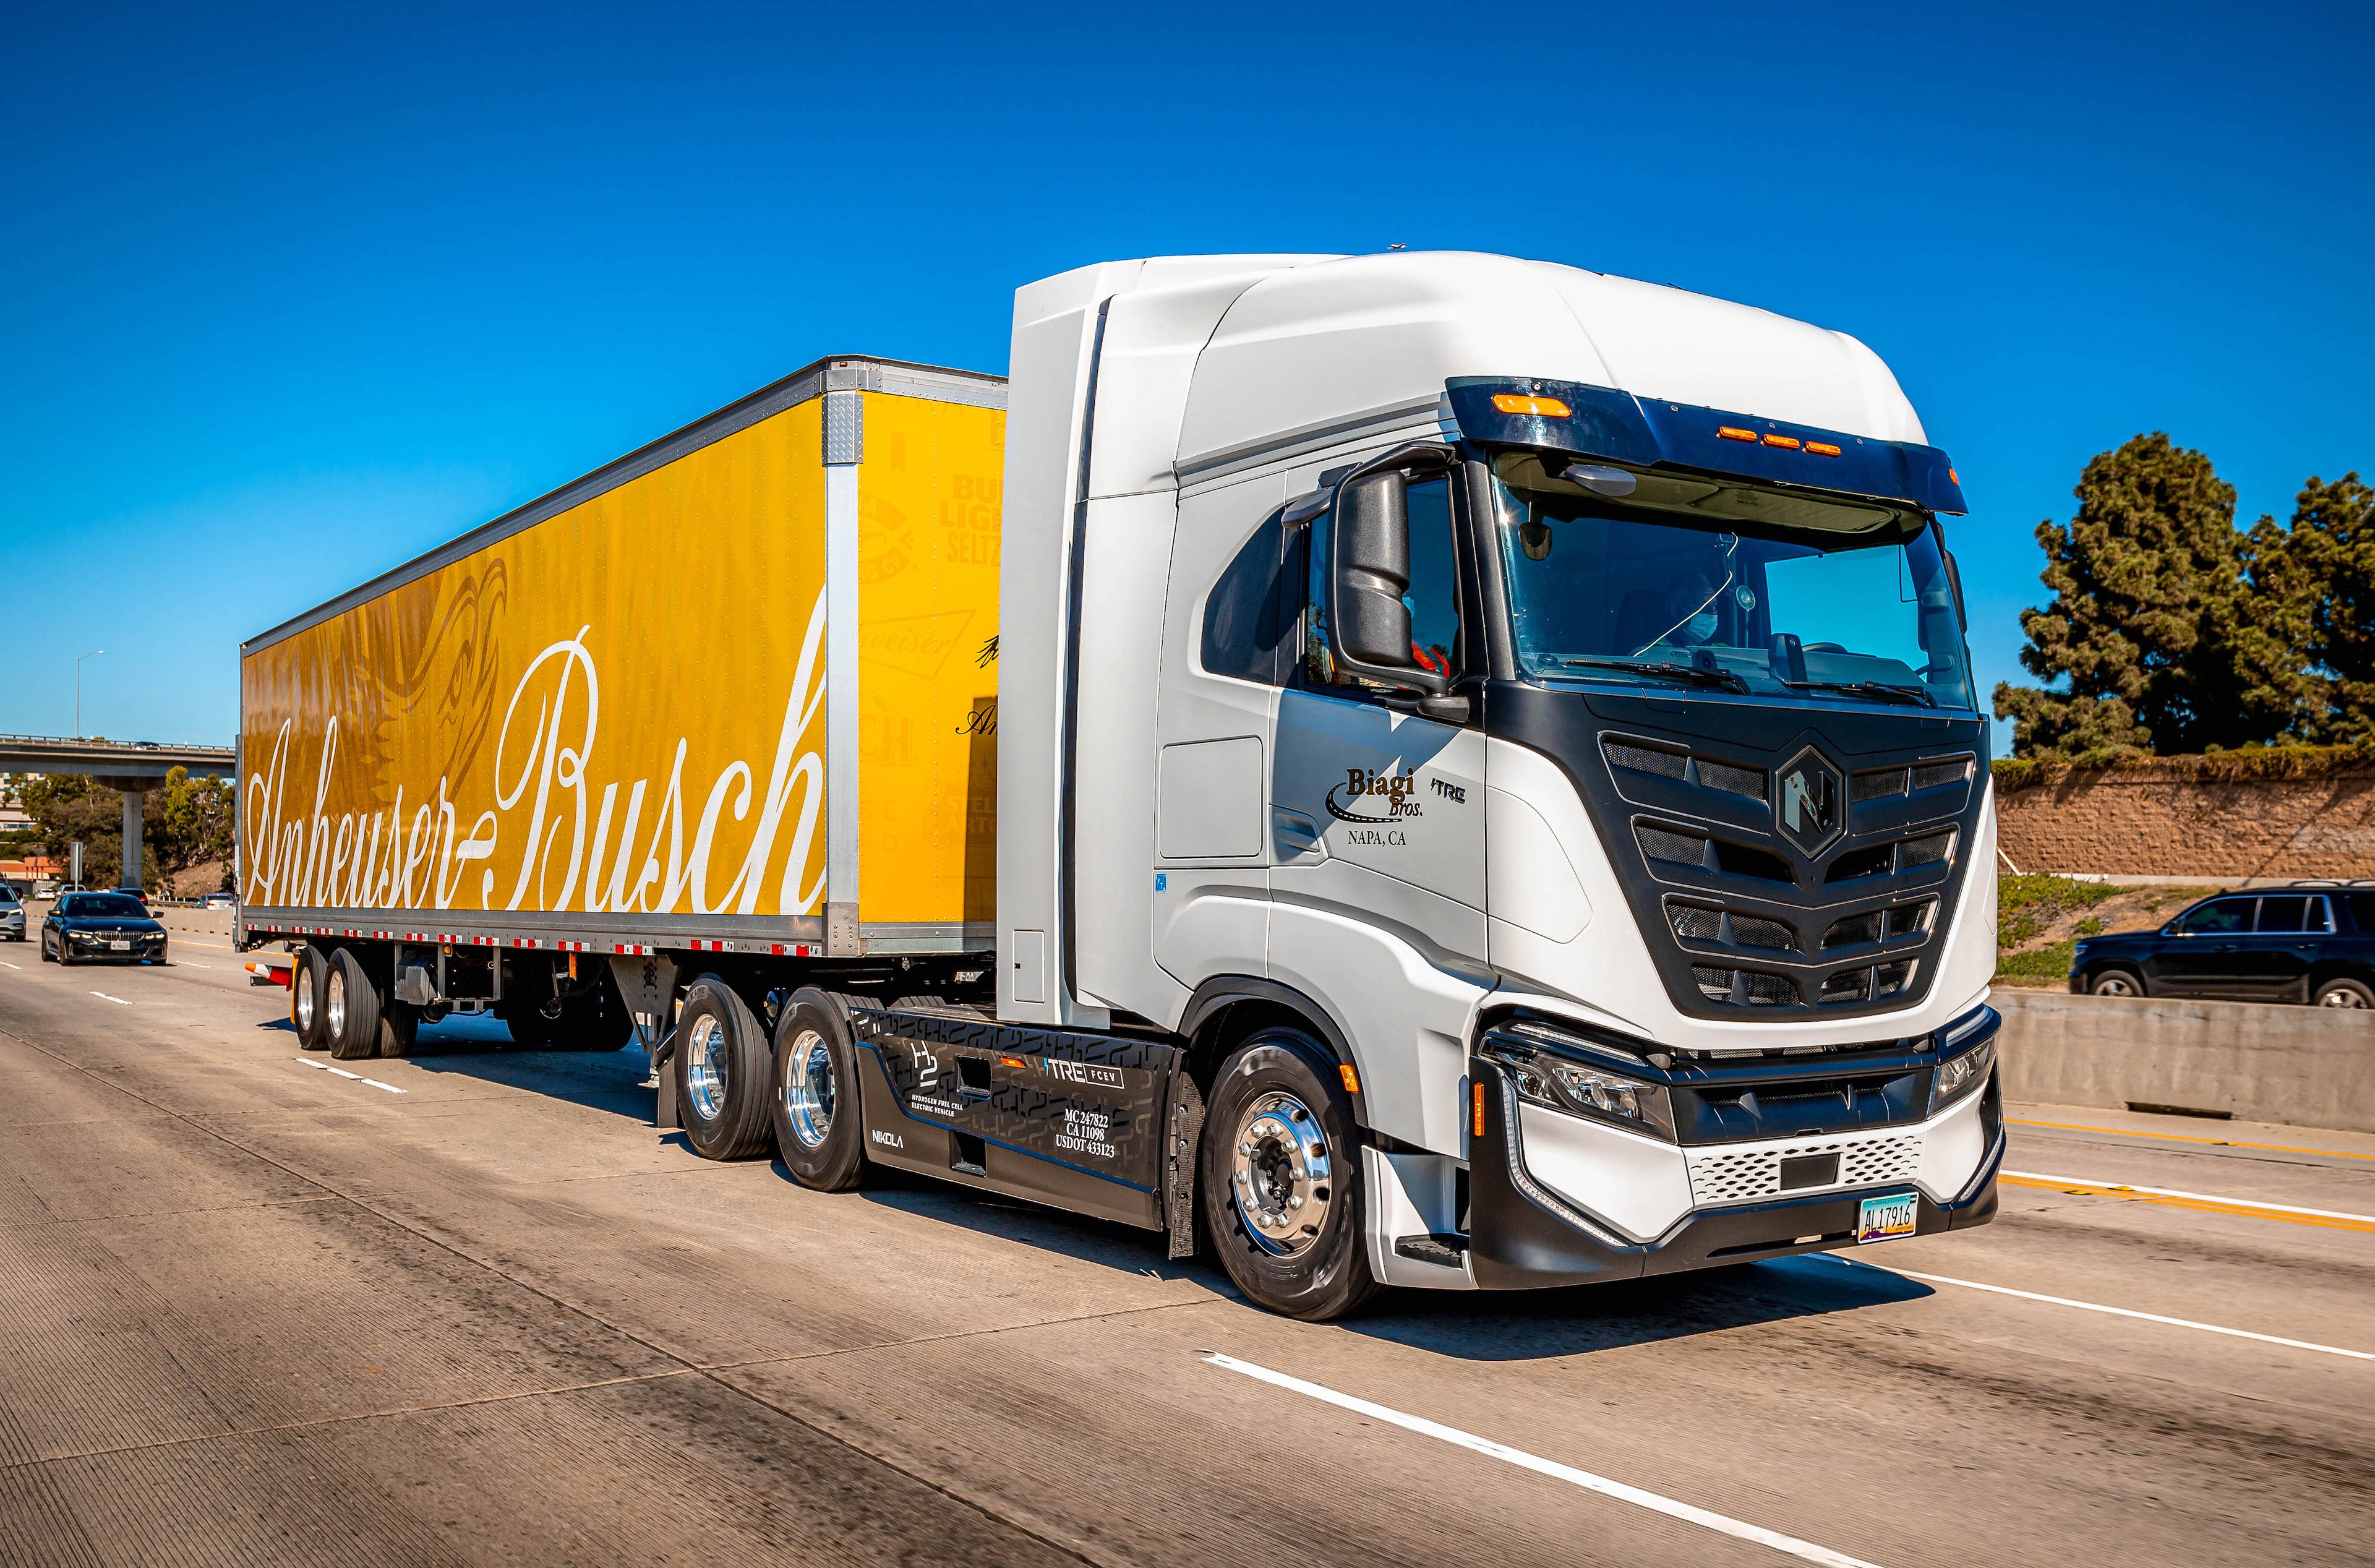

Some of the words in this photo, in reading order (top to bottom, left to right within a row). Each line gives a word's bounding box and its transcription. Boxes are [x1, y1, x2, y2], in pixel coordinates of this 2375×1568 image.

[946, 531, 1001, 567] SELTZ
[858, 626, 951, 654] weiser
[956, 705, 998, 735] An
[1346, 768, 1414, 804] Biagi
[1434, 778, 1466, 805] TRE
[1348, 831, 1385, 847] NAPA,
[1388, 831, 1406, 846] CA
[1048, 1058, 1086, 1083] TRE
[1090, 1069, 1115, 1082] FCEV
[911, 1102, 933, 1113] ELECTRIC
[934, 1107, 955, 1117] VEHICLE
[912, 1094, 938, 1105] HYDROGEN
[938, 1099, 950, 1108] FUEL
[951, 1102, 964, 1111] CELL
[1064, 1108, 1080, 1123] MC
[1080, 1112, 1108, 1128] 247822
[872, 1129, 904, 1149] NIKOLA
[1066, 1122, 1080, 1137] CA
[1081, 1125, 1105, 1142] 11098
[1056, 1134, 1087, 1152] USDOT
[1087, 1140, 1115, 1158] 433123
[1876, 1197, 1904, 1206] ARIZONA
[1865, 1205, 1911, 1232] AL17916
